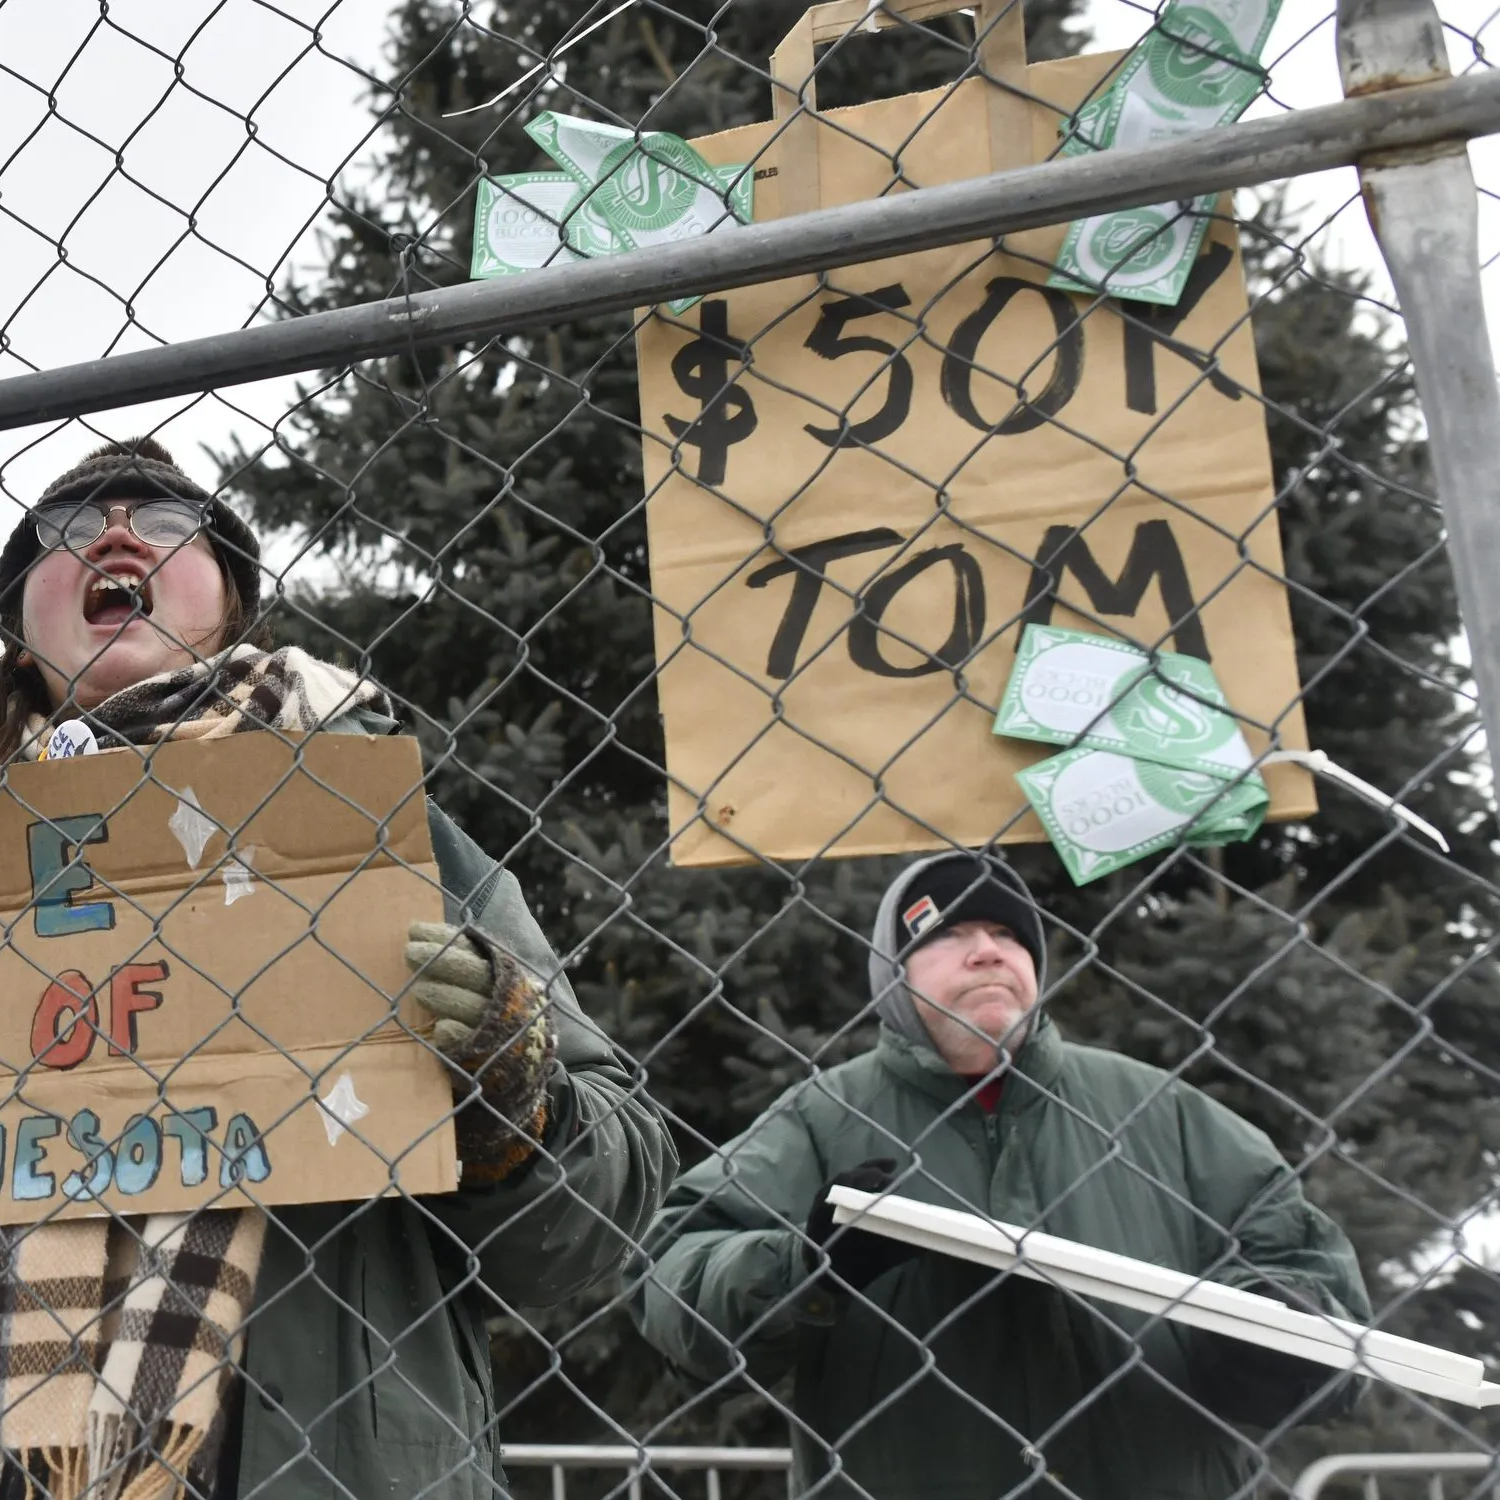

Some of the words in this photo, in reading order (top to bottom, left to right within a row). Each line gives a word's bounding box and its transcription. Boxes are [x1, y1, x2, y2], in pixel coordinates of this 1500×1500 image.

[663, 243, 1242, 486] $50K
[746, 519, 1212, 680] TOM
[29, 959, 170, 1070] OF
